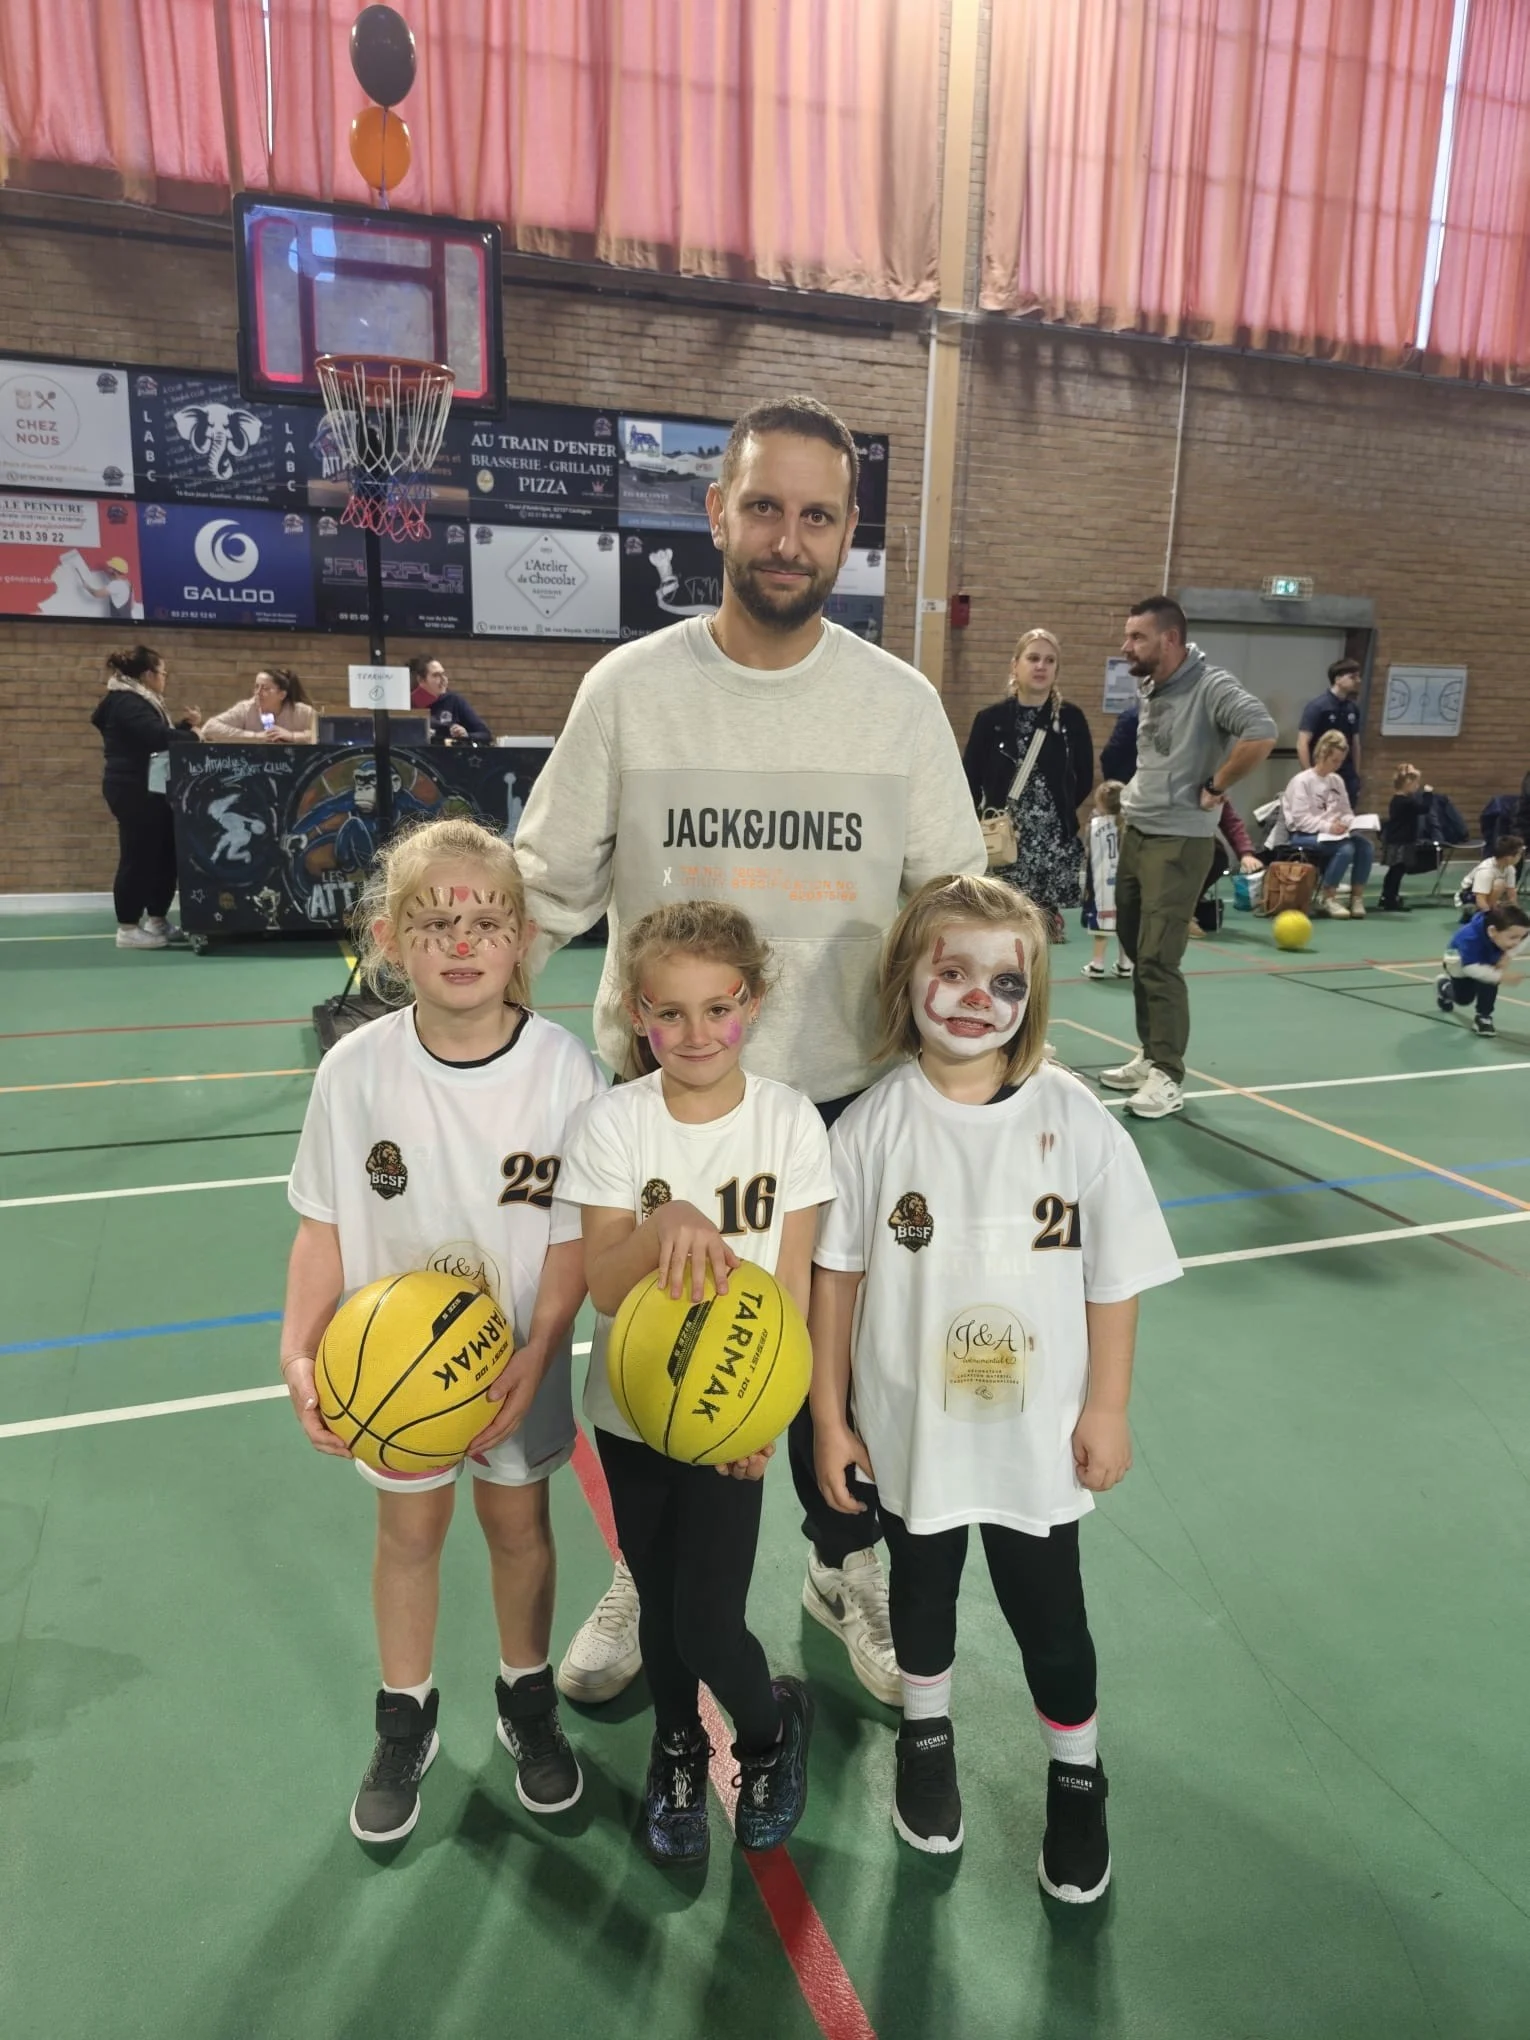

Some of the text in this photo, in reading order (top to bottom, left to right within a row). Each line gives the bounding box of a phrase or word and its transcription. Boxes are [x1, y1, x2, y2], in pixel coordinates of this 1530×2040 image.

[16, 418, 57, 432] CHEZ
[16, 433, 60, 446] NOUS
[471, 433, 617, 457] AU TRAIN D'ENFER
[471, 454, 541, 471] BRASSERIE
[549, 461, 614, 476] GRILLADE
[518, 477, 568, 495] PIZZA
[0, 500, 84, 513] LE PEINTURE
[3, 530, 64, 543] 21 83 39 22
[525, 560, 568, 573] L'Atelier
[528, 572, 576, 586] Chocolat
[183, 586, 275, 603] GALLOO
[663, 807, 863, 852] JACK&JONES
[322, 870, 345, 882] LES
[310, 881, 355, 918] ATT
[372, 1171, 406, 1188] BCSF
[498, 1151, 561, 1210] 22
[714, 1172, 777, 1237] 16
[1031, 1193, 1082, 1251] 21
[897, 1225, 931, 1239] BCSF
[953, 1319, 1018, 1360] J&A
[692, 1290, 763, 1424] TARMAK
[475, 1364, 489, 1381] 100
[916, 1733, 948, 1748] SKECHERS
[1057, 1775, 1093, 1789] SKECHERS
